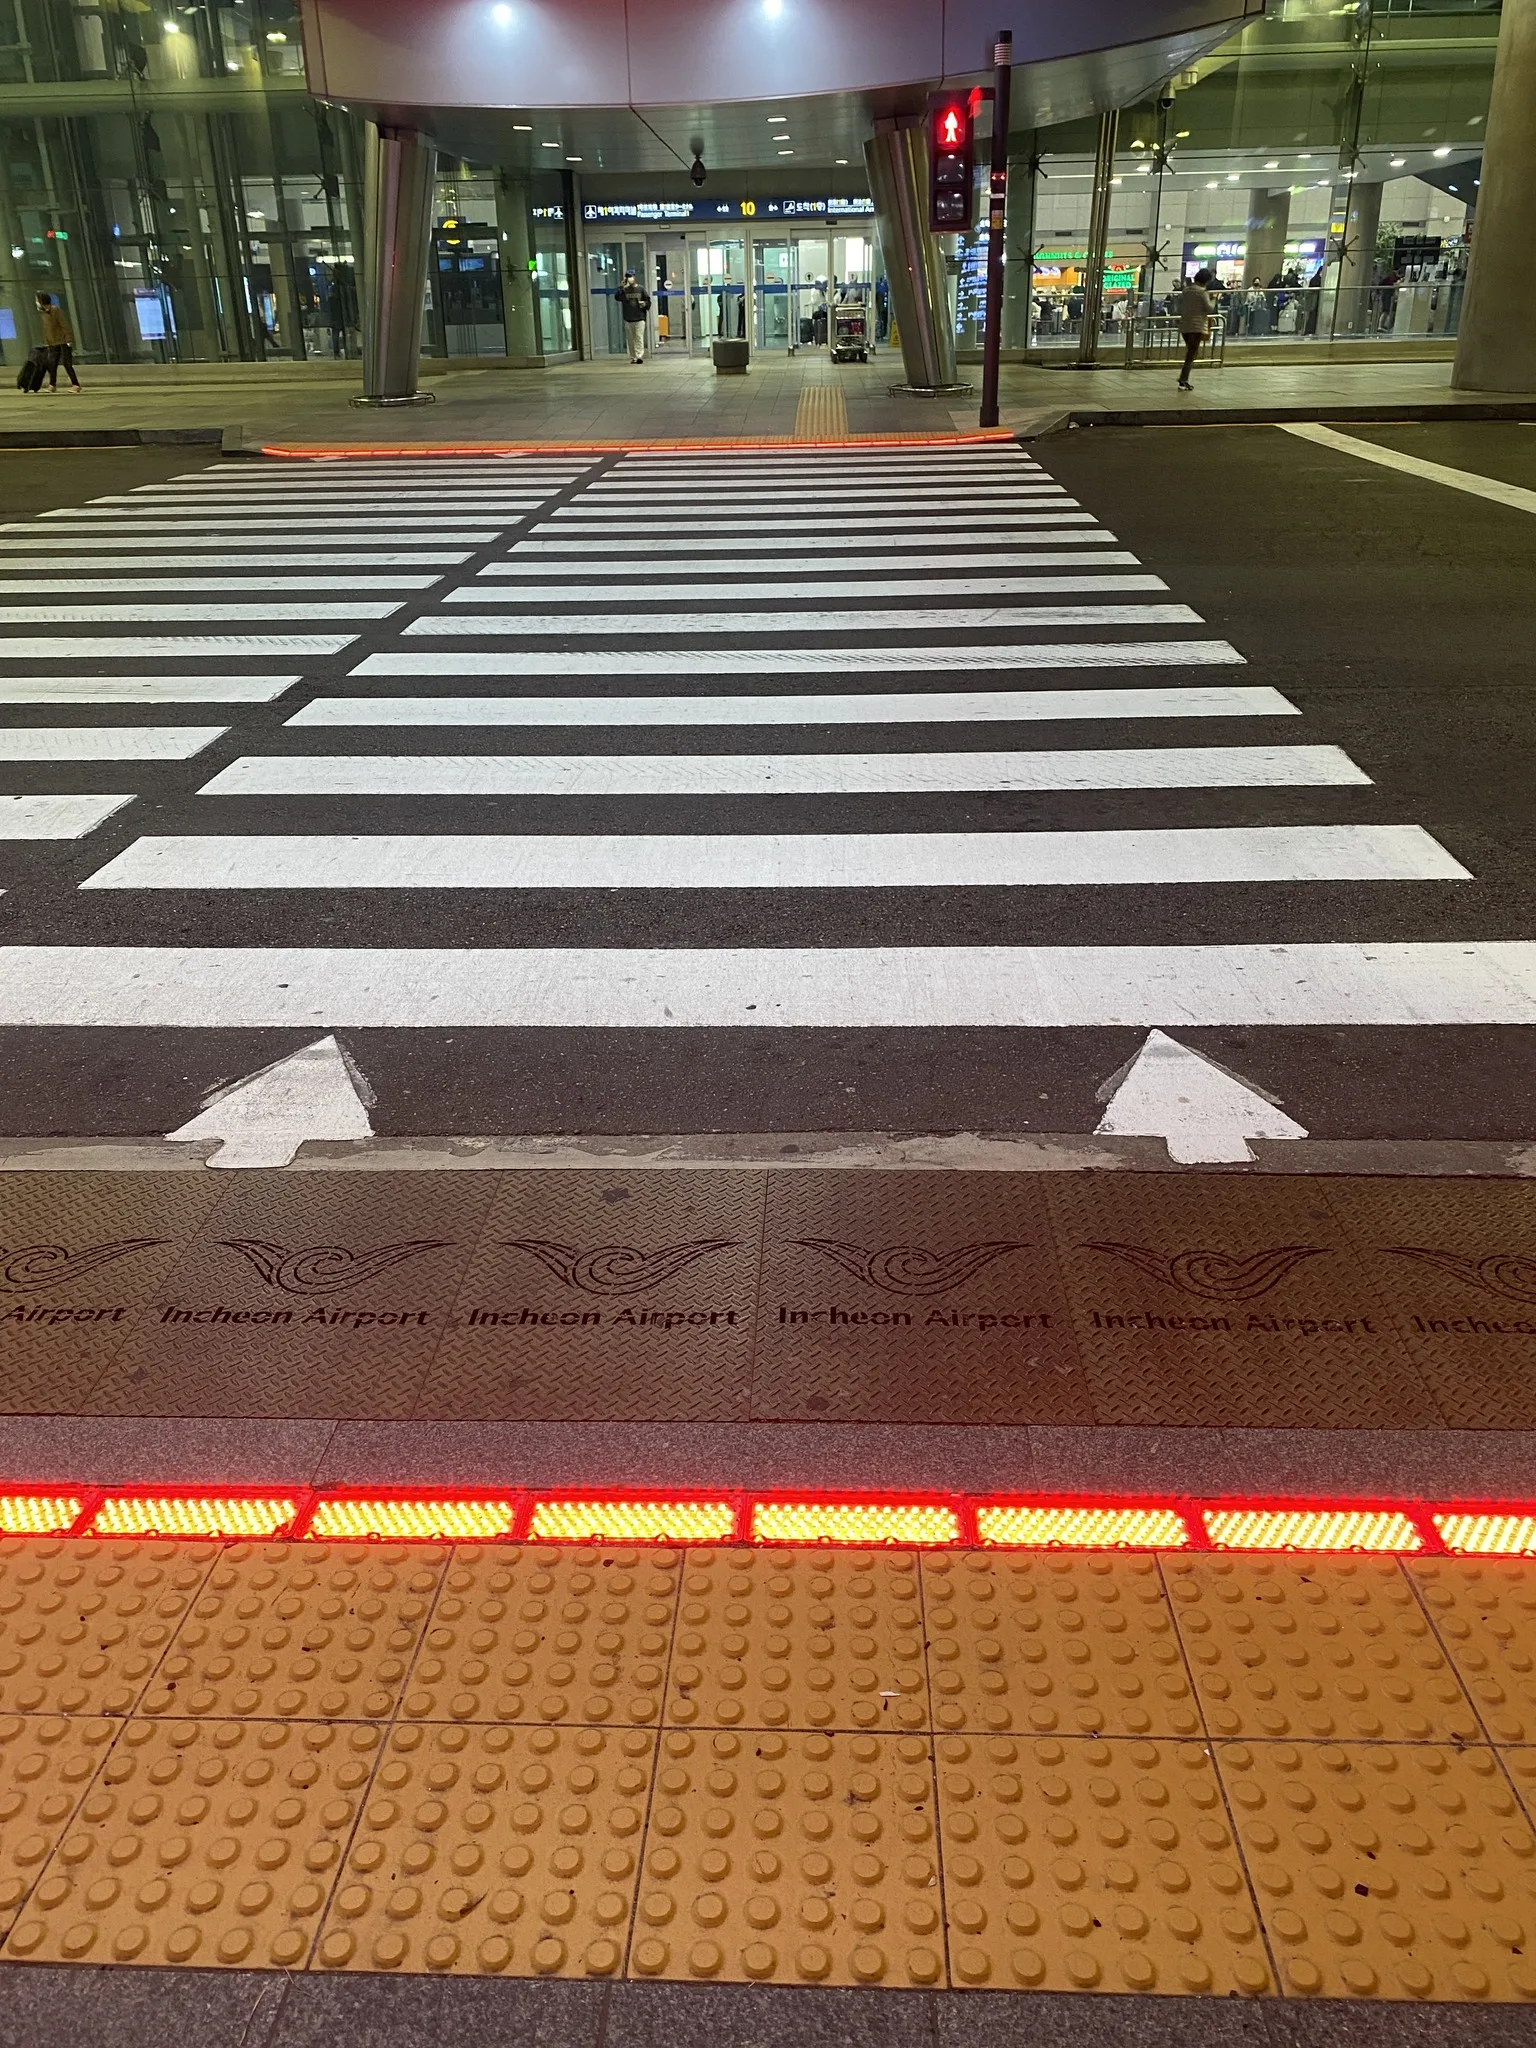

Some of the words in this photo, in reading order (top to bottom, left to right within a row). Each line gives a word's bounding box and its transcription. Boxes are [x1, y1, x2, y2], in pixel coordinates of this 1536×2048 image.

[739, 201, 756, 216] 10
[1103, 281, 1132, 289] GLAZED
[4, 1304, 127, 1326] Airport
[159, 1306, 294, 1324] Incheon
[301, 1306, 431, 1329] Airport
[467, 1308, 602, 1326] Incheon
[611, 1308, 740, 1329] Airport
[779, 1306, 912, 1326] Incheon
[925, 1309, 1053, 1331] Airport
[1092, 1311, 1232, 1331] Incheon
[1247, 1313, 1379, 1336] Airport
